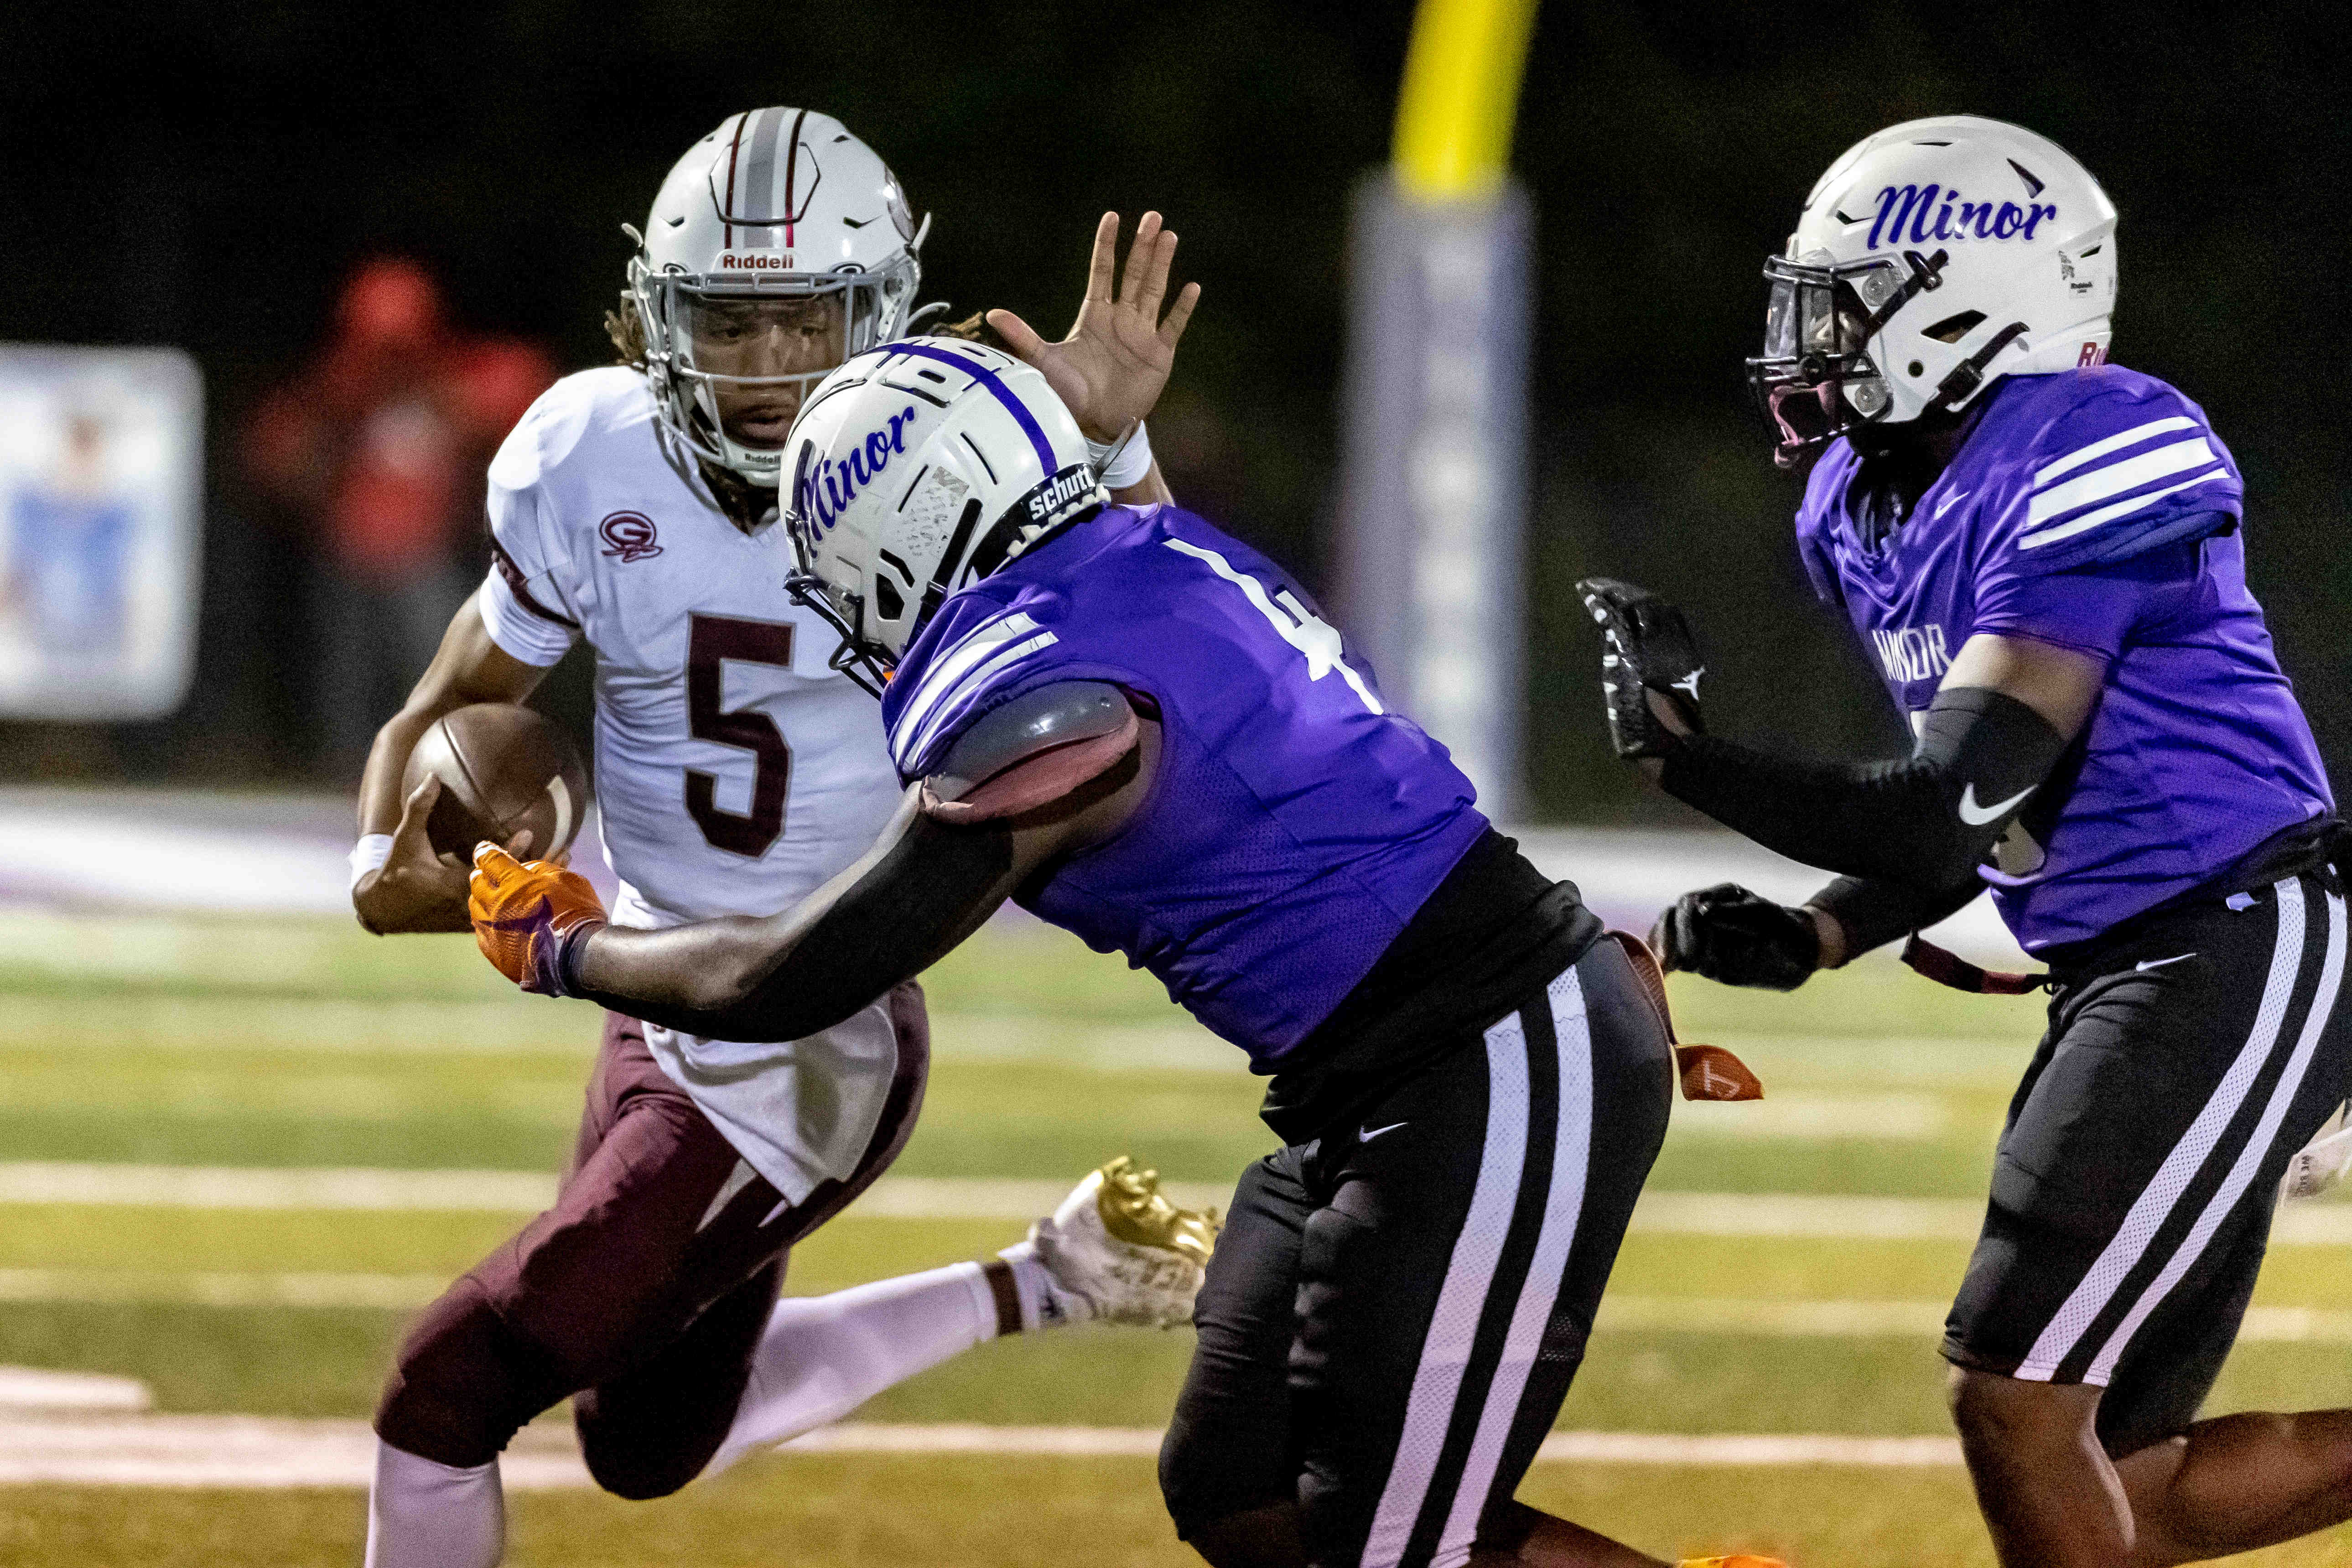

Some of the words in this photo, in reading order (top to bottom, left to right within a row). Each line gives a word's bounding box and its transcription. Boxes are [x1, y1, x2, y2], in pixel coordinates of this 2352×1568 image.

[723, 254, 793, 268] Riddell
[1868, 184, 2056, 250] Minor
[799, 406, 914, 559] Minor
[1163, 538, 1384, 716] 4
[684, 611, 796, 861] 5
